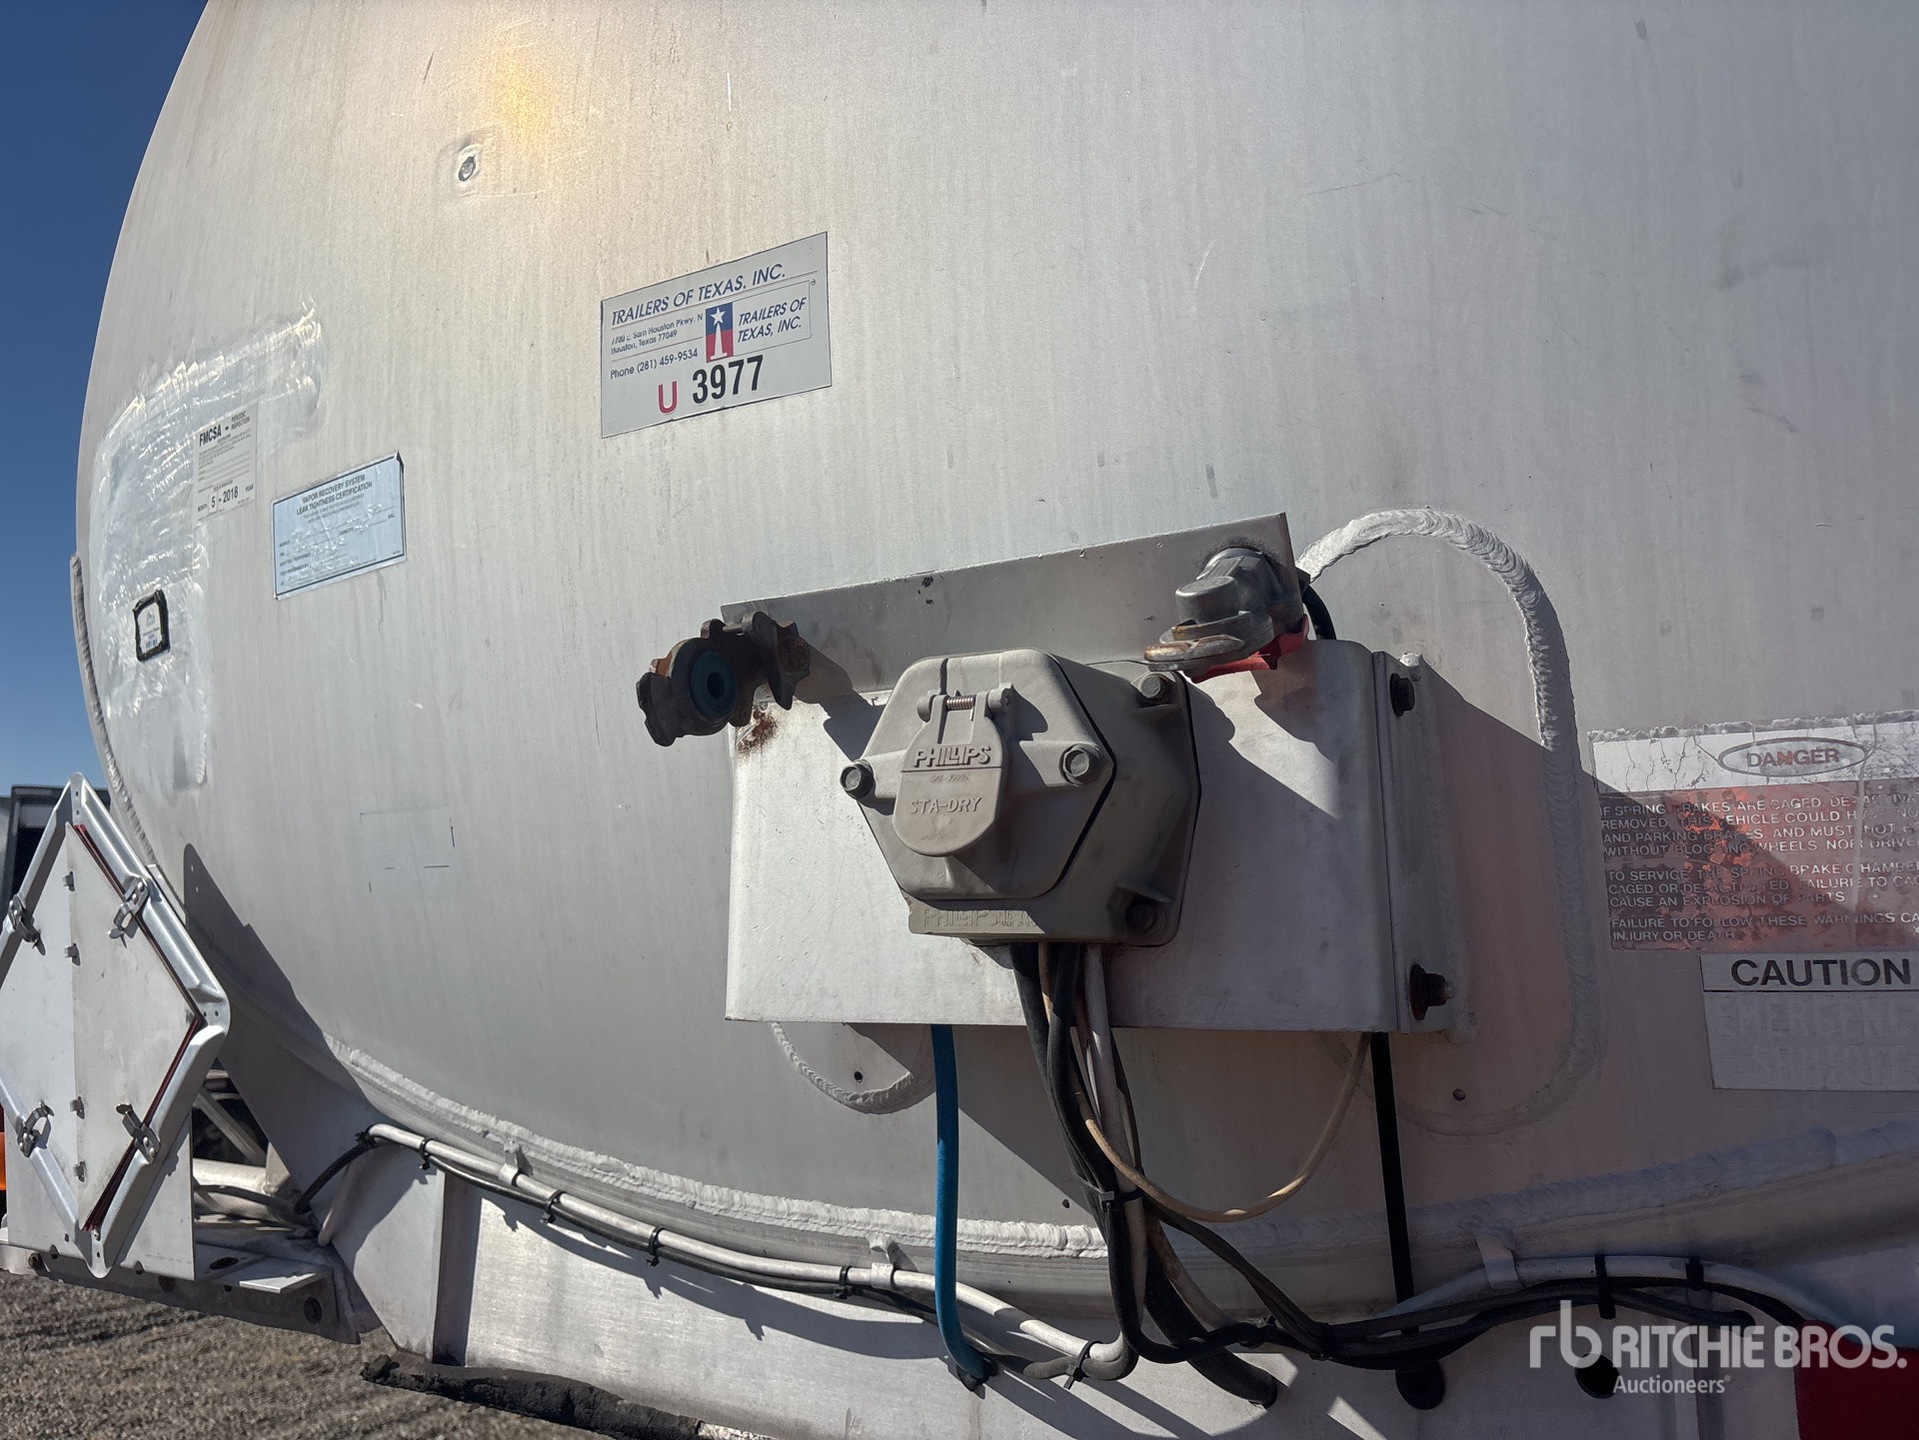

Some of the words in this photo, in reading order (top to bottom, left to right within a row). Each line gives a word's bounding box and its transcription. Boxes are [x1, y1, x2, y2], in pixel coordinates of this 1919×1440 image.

[611, 296, 669, 326] TRAILERS
[673, 289, 693, 307] OF
[752, 263, 786, 286] INC.
[738, 303, 787, 326] TRAILERS
[789, 297, 807, 313] OF
[648, 321, 675, 335] Houston
[676, 316, 696, 328] Pkwy.
[697, 313, 703, 321] N
[737, 322, 774, 344] TEXAS,
[777, 316, 802, 333] INC.
[638, 336, 657, 347] Texas
[658, 329, 678, 341] 77049
[610, 366, 635, 379] Phone
[637, 358, 657, 373] (281)
[659, 347, 698, 366] 459-9534
[658, 381, 678, 414] U
[692, 354, 764, 405] 3977
[199, 424, 221, 447] FMCSA
[318, 481, 344, 497] RECOVERY
[345, 473, 366, 487] SYSTEM
[335, 480, 373, 501] CERTIFICATION
[211, 495, 216, 508] 5
[223, 485, 239, 504] 2018
[913, 745, 992, 768] PHILLIPS
[1745, 748, 1839, 768] DANGER
[910, 796, 982, 814] STA-DRY
[1600, 806, 1611, 816] IF
[1674, 801, 1730, 813] RAKES
[1718, 812, 1780, 826] EHICLE
[1785, 810, 1840, 824] COULD
[1603, 831, 1631, 844] AND
[1635, 829, 1698, 843] PARKING
[1773, 827, 1805, 838] AND
[1810, 825, 1855, 837] MUST
[1604, 844, 1668, 857] WITHOUT
[1758, 840, 1818, 852] WHEELS
[1609, 871, 1625, 881] TO
[1629, 869, 1688, 881] SERVICE
[1730, 866, 1785, 879] SPRING
[1789, 863, 1841, 875] BRAKE
[1608, 883, 1653, 895] CAGED
[1658, 883, 1679, 894] OR
[1868, 876, 1887, 888] TO
[1609, 896, 1654, 908] CAUSE
[1658, 896, 1677, 907] AN
[1612, 917, 1665, 929] FAILURE
[1671, 917, 1689, 928] TO
[1760, 915, 1807, 926] THESE
[1613, 931, 1659, 941] INJURY
[1662, 931, 1683, 942] OR
[1730, 958, 1912, 986] CAUTION
